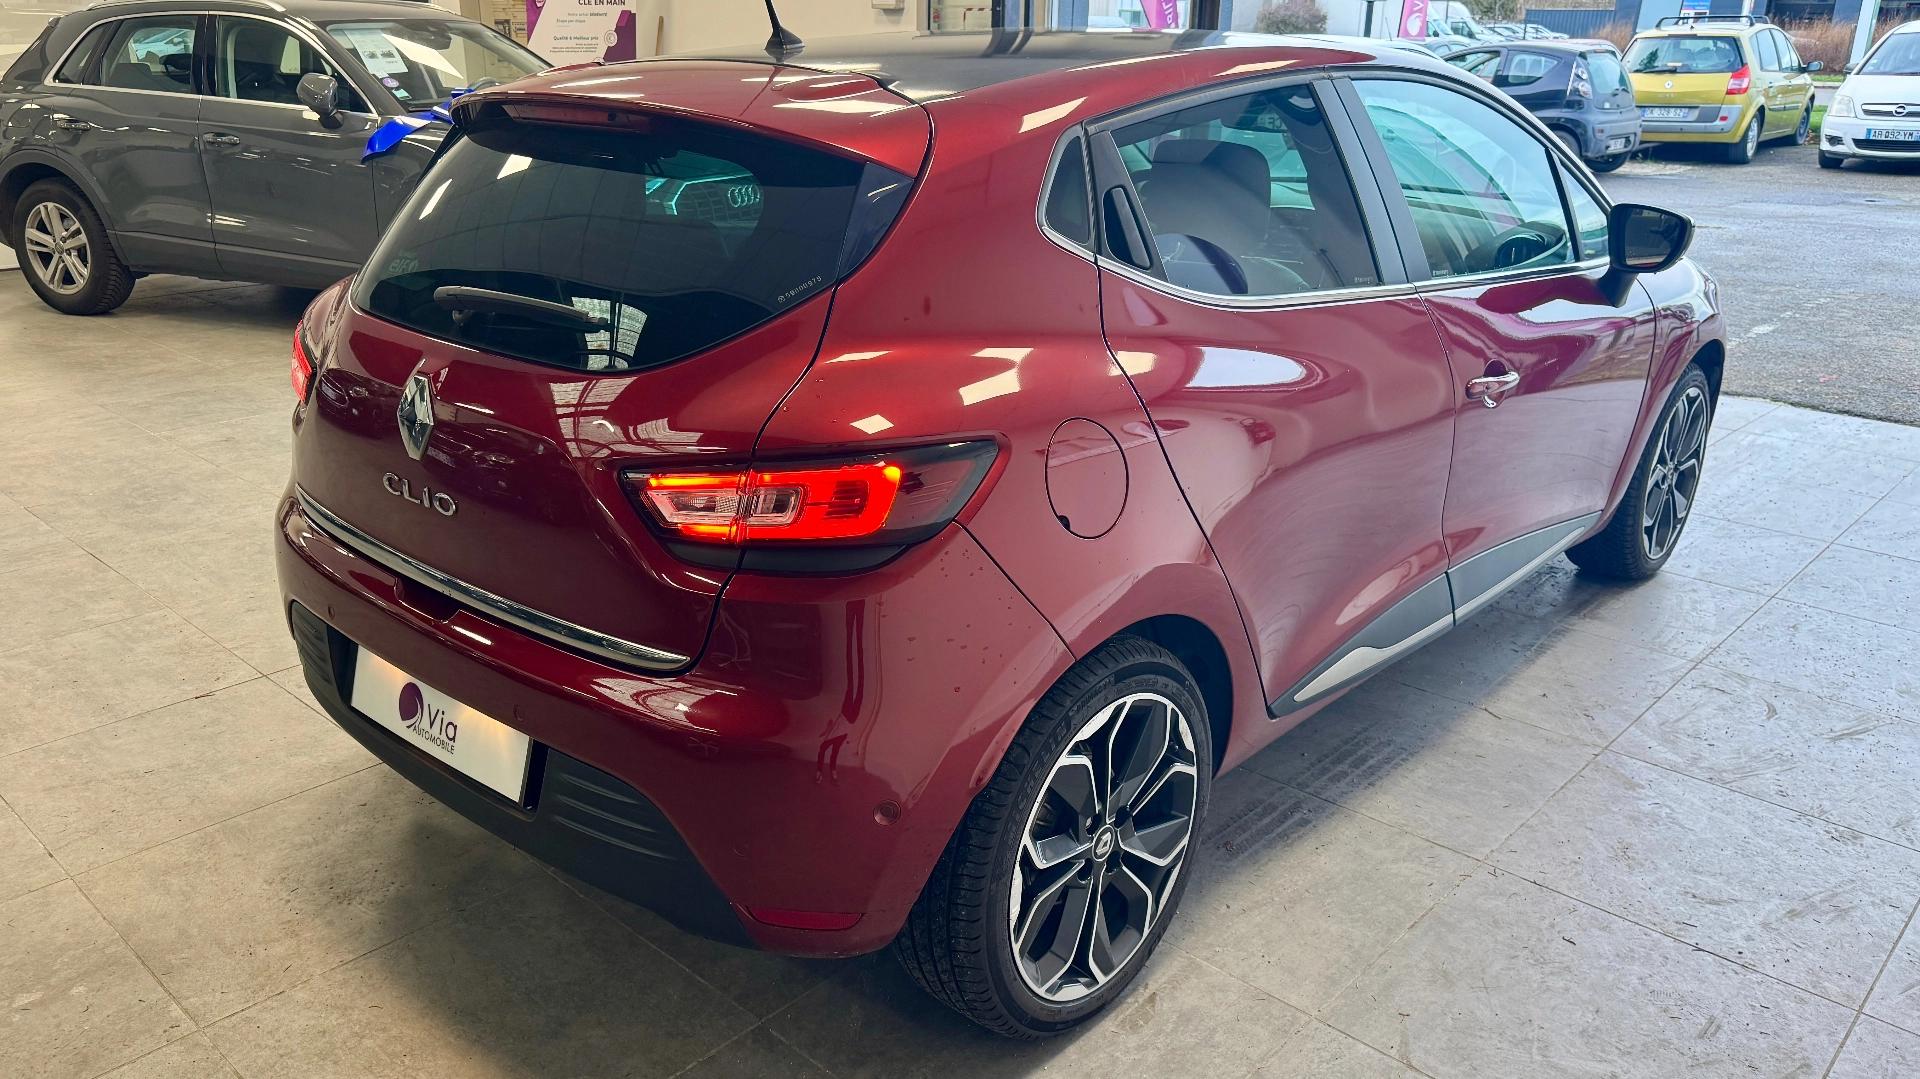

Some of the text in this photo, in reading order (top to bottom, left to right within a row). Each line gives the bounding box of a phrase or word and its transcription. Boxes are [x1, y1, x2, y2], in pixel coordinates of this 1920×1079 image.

[382, 472, 456, 516] CLIO
[412, 724, 455, 755] AUTOMOBILE
[427, 703, 458, 743] Via
